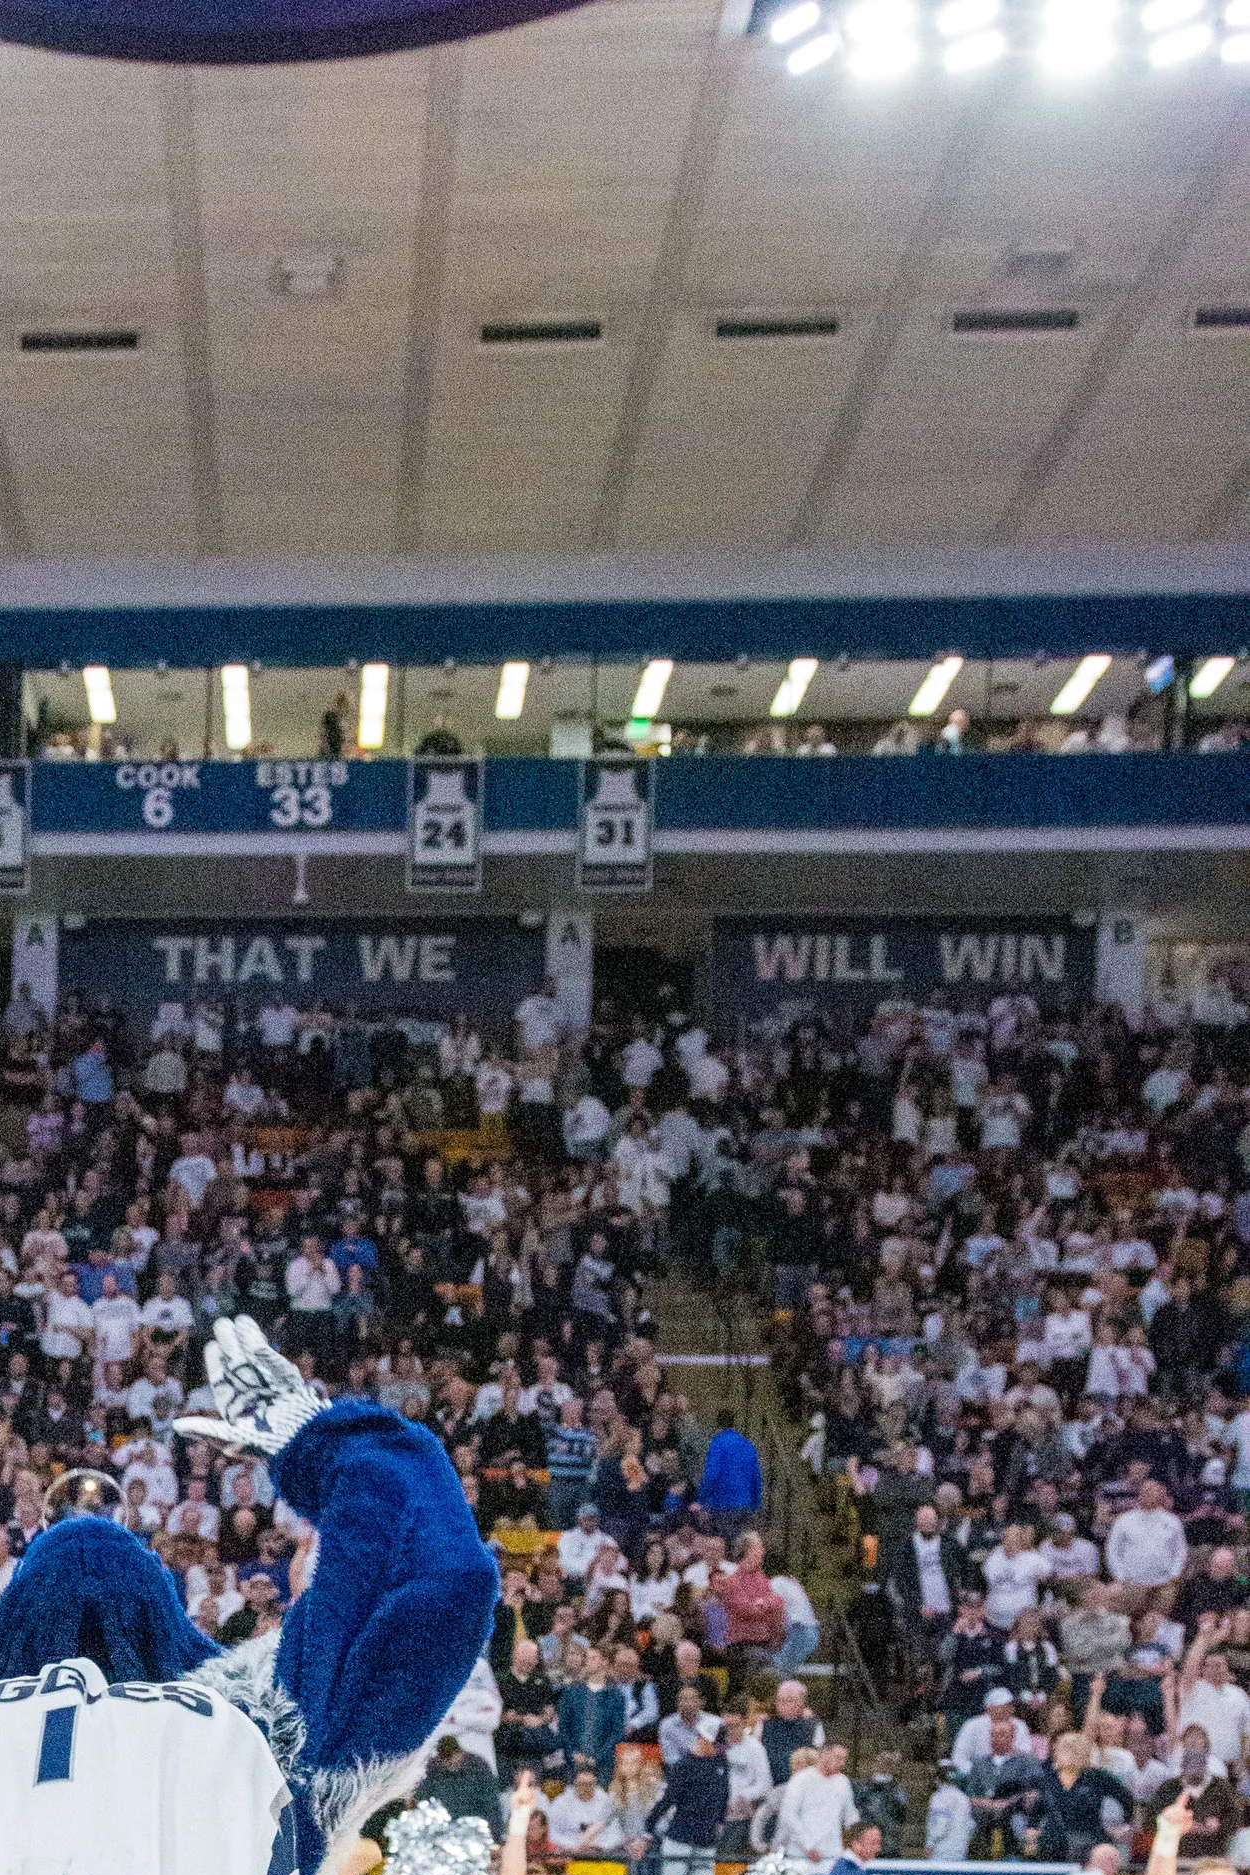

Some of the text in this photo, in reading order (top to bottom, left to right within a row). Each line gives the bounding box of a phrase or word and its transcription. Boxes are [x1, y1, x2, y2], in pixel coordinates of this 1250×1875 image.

[116, 764, 201, 789] COOK
[256, 762, 348, 788] ESTES
[143, 788, 174, 828] 6
[270, 787, 333, 828] 33
[422, 821, 467, 848] 24
[596, 819, 636, 846] 31
[156, 935, 456, 982] THAT WE
[754, 933, 1066, 981] WILL WIN
